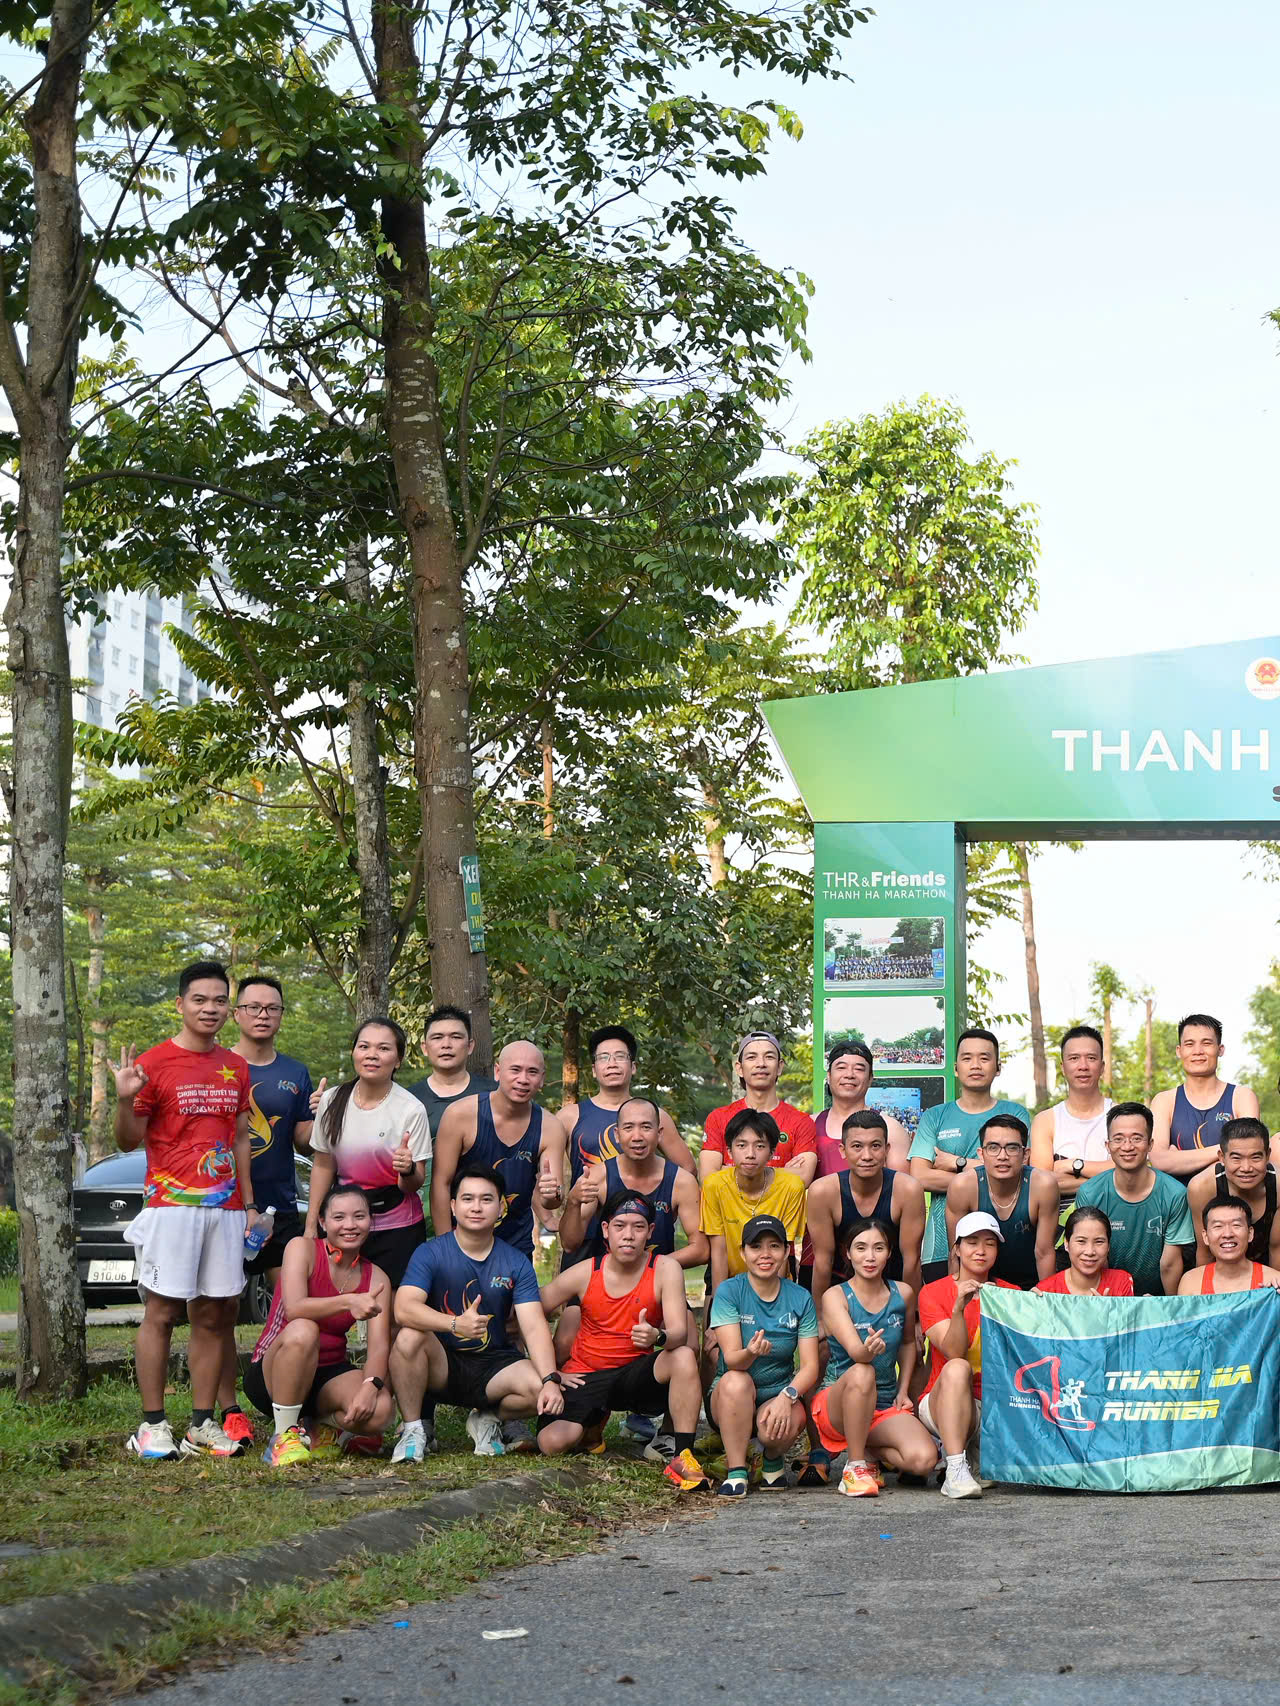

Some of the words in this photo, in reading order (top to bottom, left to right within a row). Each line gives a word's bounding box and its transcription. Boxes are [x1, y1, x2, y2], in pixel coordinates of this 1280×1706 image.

[1051, 729, 1270, 771] THANH
[823, 890, 860, 900] THANH
[865, 890, 880, 900] HA
[884, 889, 947, 899] MARATHON
[111, 1201, 126, 1210] KIA
[1104, 1369, 1201, 1391] THANH
[1208, 1364, 1253, 1388] HA
[1009, 1395, 1031, 1403] THANH
[1101, 1399, 1221, 1421] RUNNER
